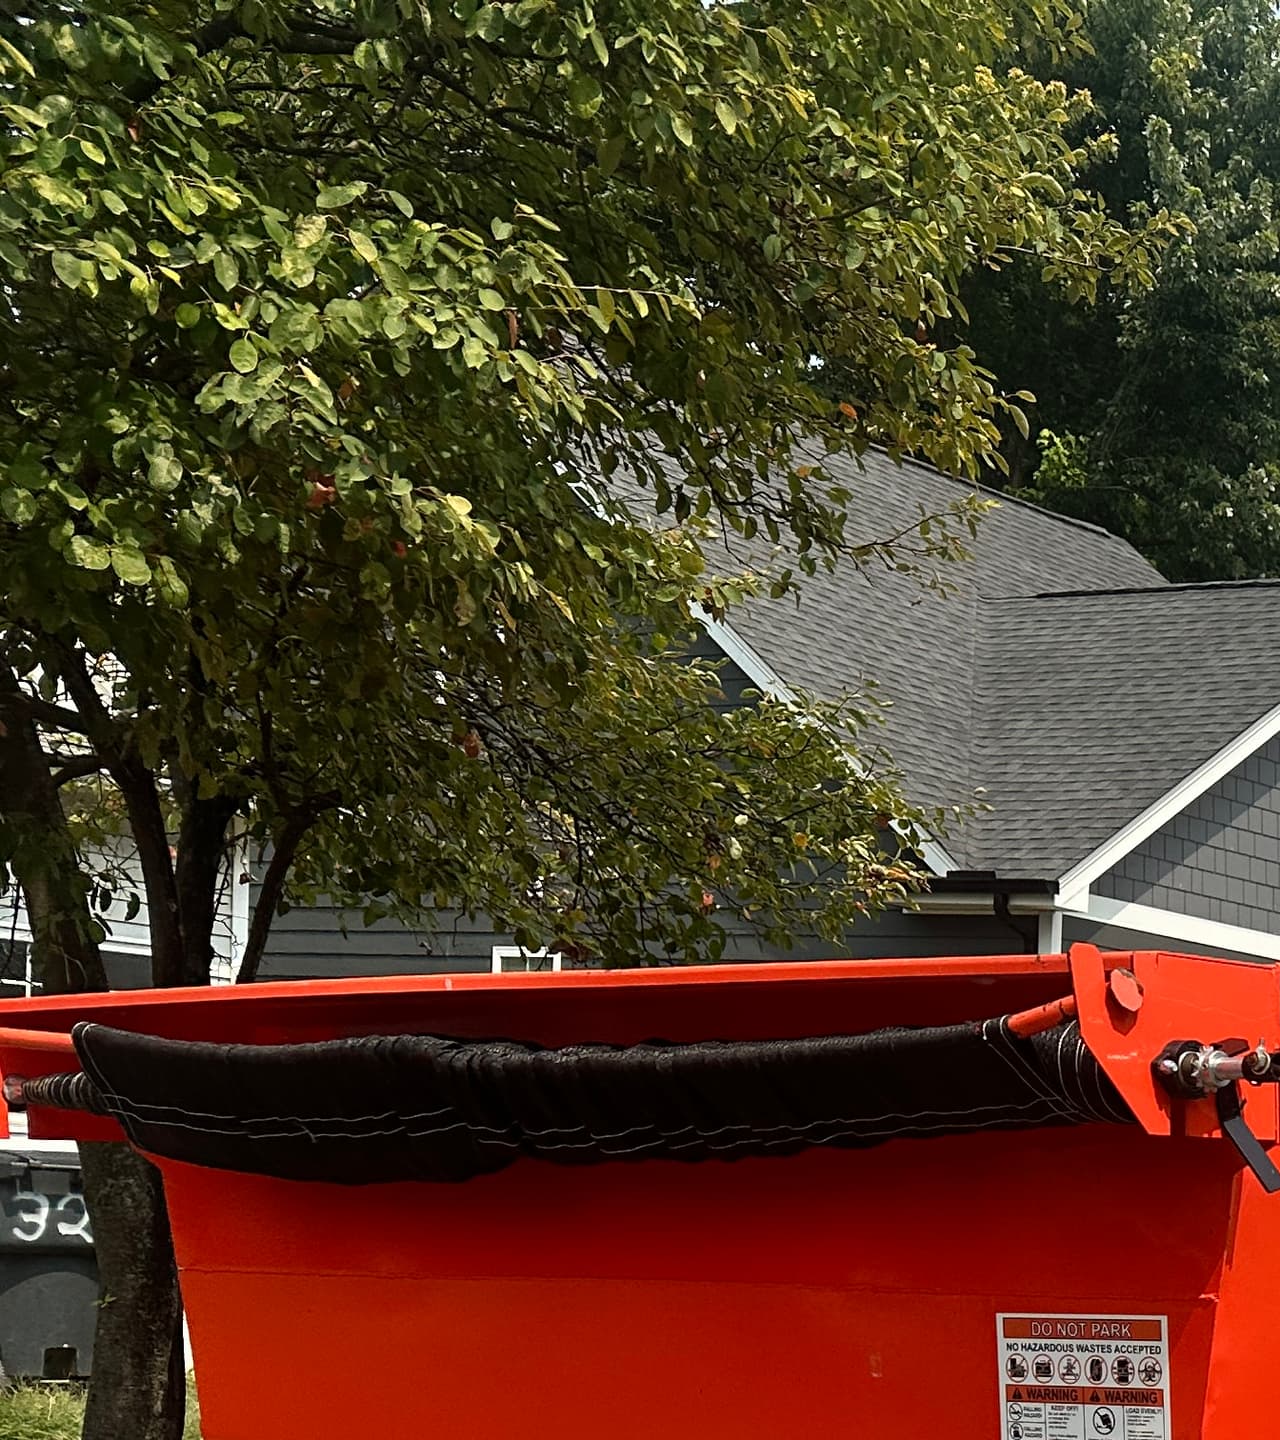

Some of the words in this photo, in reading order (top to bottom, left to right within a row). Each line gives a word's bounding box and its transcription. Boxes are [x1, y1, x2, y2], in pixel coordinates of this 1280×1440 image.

[1031, 1321, 1052, 1336] DO
[1056, 1322, 1086, 1337] NOT
[1091, 1323, 1132, 1338] PARK
[1006, 1342, 1019, 1352] NO
[1020, 1342, 1074, 1353] HAZARDOUS
[1076, 1343, 1113, 1354] WASTES
[1114, 1344, 1162, 1355] ACCEPTED
[1026, 1387, 1079, 1402] WARNING
[1104, 1390, 1157, 1404] WARNING
